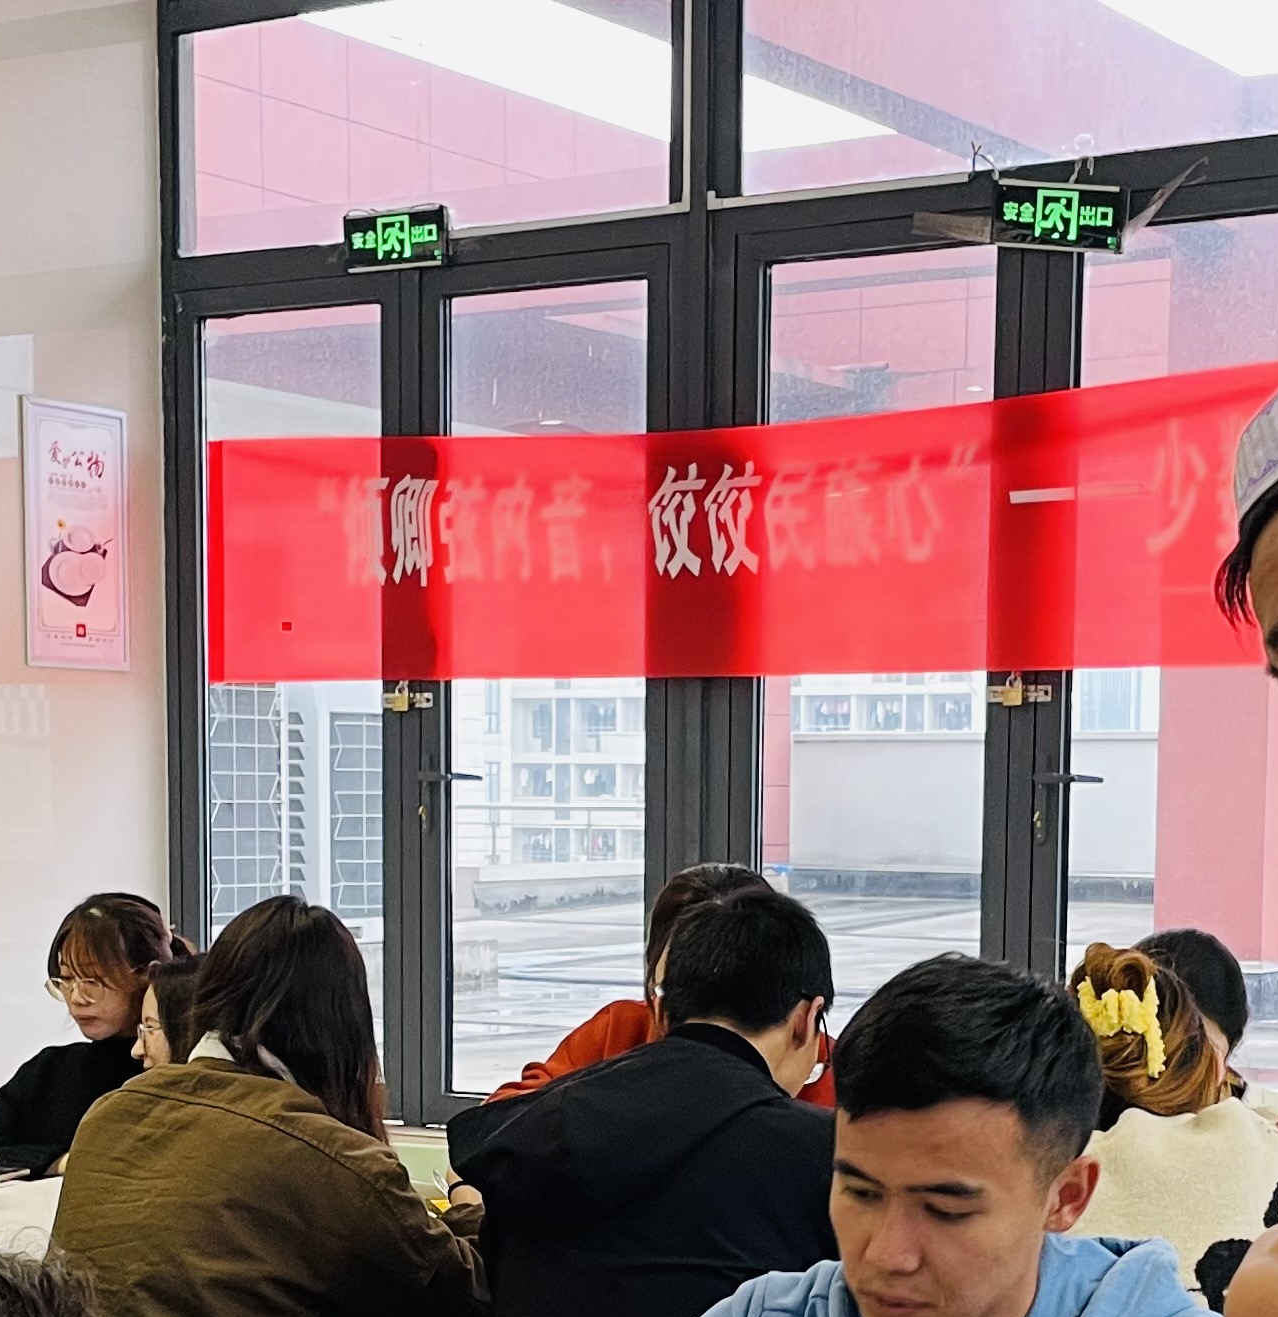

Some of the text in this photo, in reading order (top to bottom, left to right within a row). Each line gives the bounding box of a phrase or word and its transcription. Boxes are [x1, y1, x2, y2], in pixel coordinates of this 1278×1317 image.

[1003, 201, 1113, 228] 安全 出口
[411, 223, 438, 244] 出口
